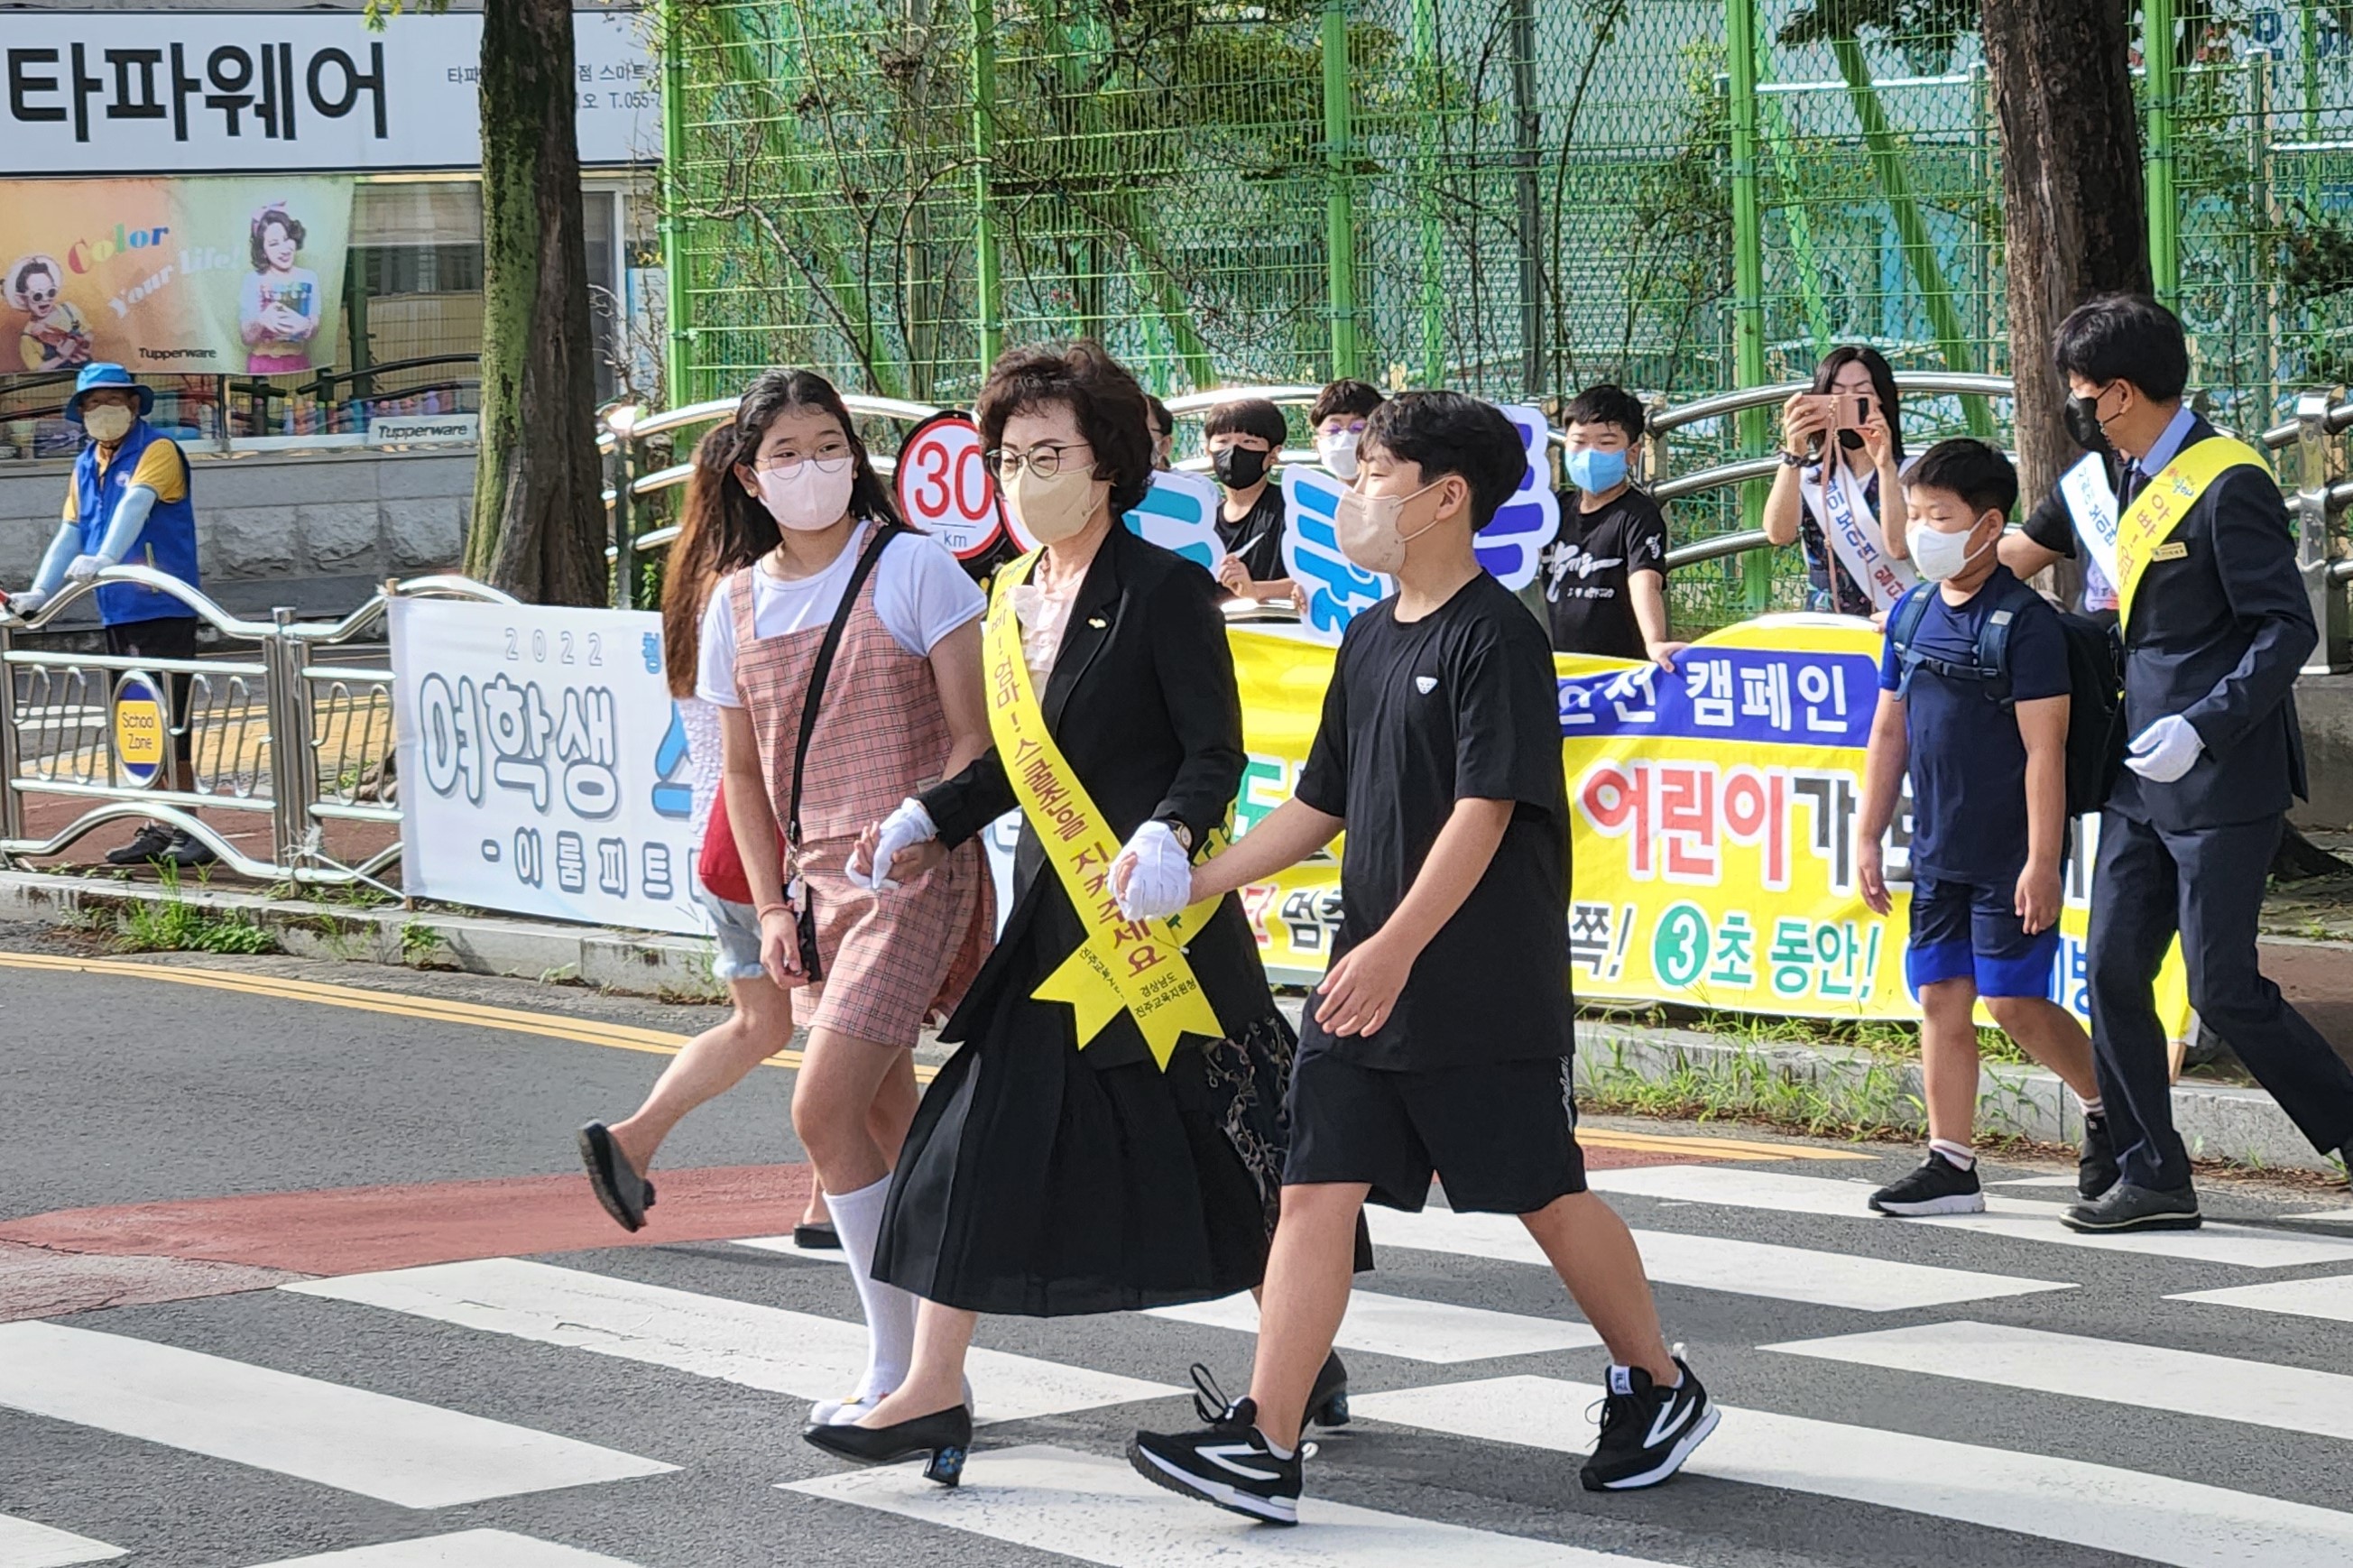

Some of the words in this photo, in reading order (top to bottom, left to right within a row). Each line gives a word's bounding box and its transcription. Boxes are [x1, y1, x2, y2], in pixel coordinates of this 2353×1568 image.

[6, 41, 388, 143] 타파웨어
[577, 92, 599, 109] 오
[68, 223, 170, 274] Color
[107, 264, 175, 319] your
[138, 347, 217, 361] Tupperware
[378, 425, 468, 440] Tupperware
[915, 440, 996, 521] 30
[944, 530, 968, 549] km
[2129, 493, 2171, 549] 아빠!
[505, 627, 603, 666] 2022
[122, 711, 155, 729] School
[1684, 659, 1848, 733] 캠페인
[127, 733, 152, 751] Zone
[420, 671, 621, 821] 여학생
[993, 653, 1021, 734] 엄마!
[1014, 737, 1090, 844] 스쿨존을
[1583, 767, 1857, 887] 어린이가
[1139, 972, 1178, 998] 경상남도
[1770, 920, 1880, 1000] 동안!
[1134, 977, 1197, 1019] 진주교육지원청
